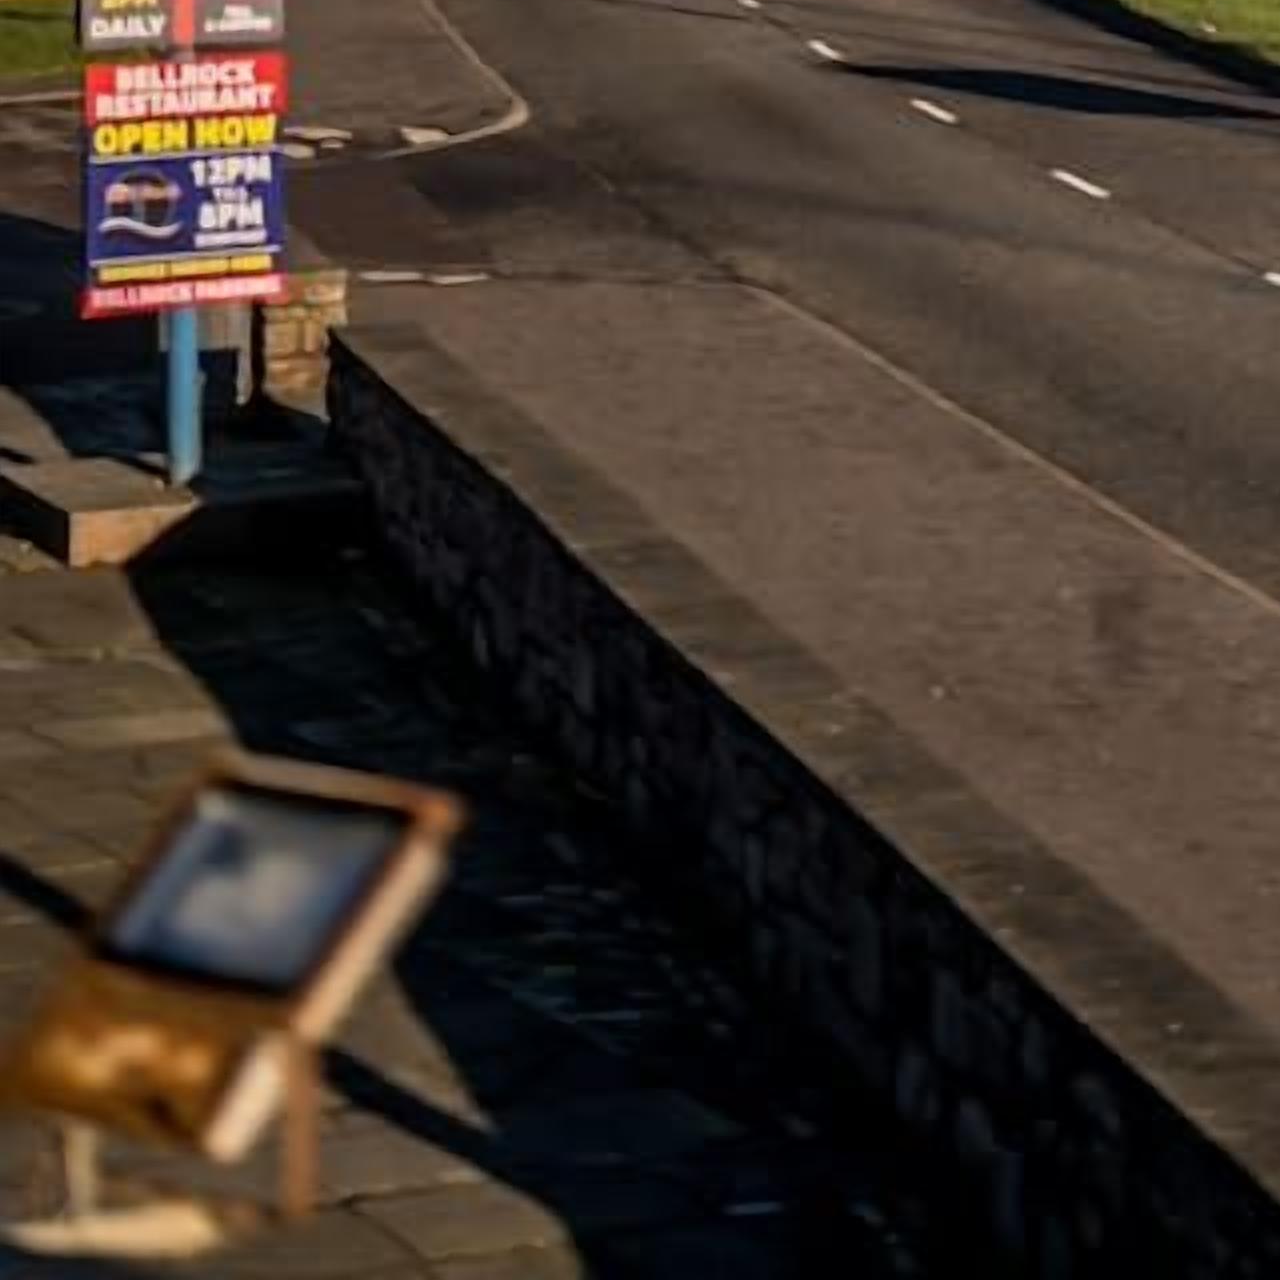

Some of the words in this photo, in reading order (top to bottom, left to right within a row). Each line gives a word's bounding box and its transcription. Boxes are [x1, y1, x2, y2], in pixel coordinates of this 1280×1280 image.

[90, 13, 165, 39] DAILY
[96, 84, 276, 120] RESTAURANT
[94, 118, 188, 154] OPEN
[195, 113, 277, 148] NOW
